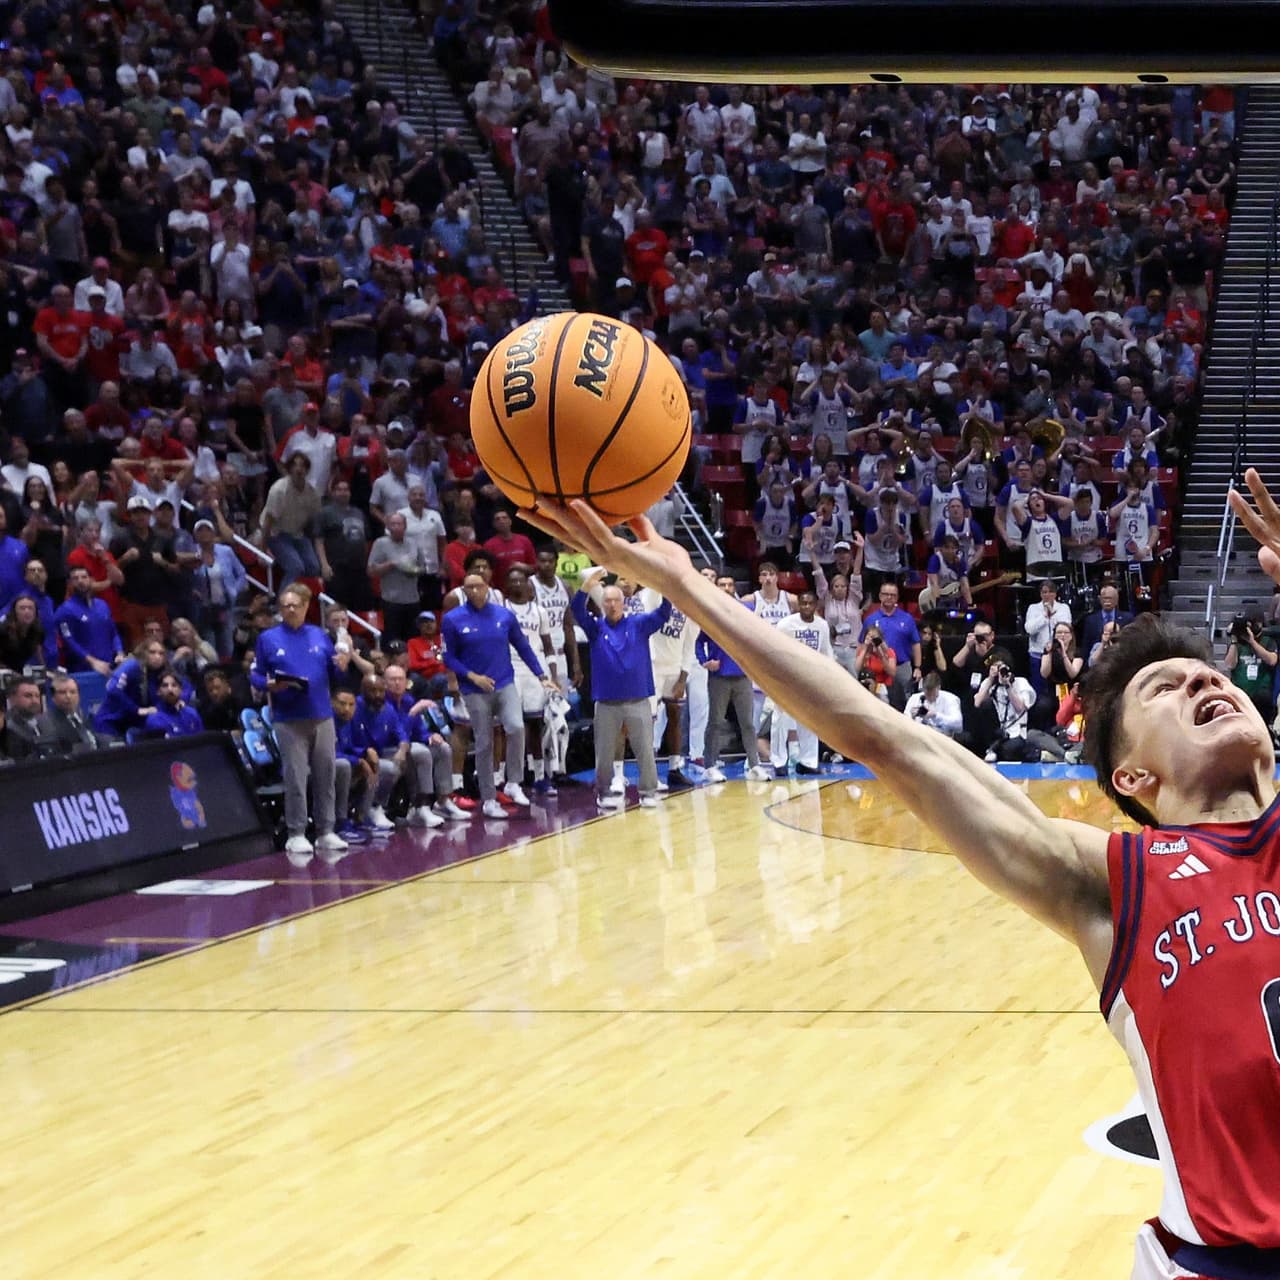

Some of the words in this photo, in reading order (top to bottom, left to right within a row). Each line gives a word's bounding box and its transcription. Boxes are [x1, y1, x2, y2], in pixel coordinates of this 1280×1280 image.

[573, 319, 622, 398] NCAA
[1042, 534, 1053, 549] 6
[1128, 520, 1138, 534] 6
[33, 788, 130, 849] KANSAS
[1153, 908, 1216, 989] ST.
